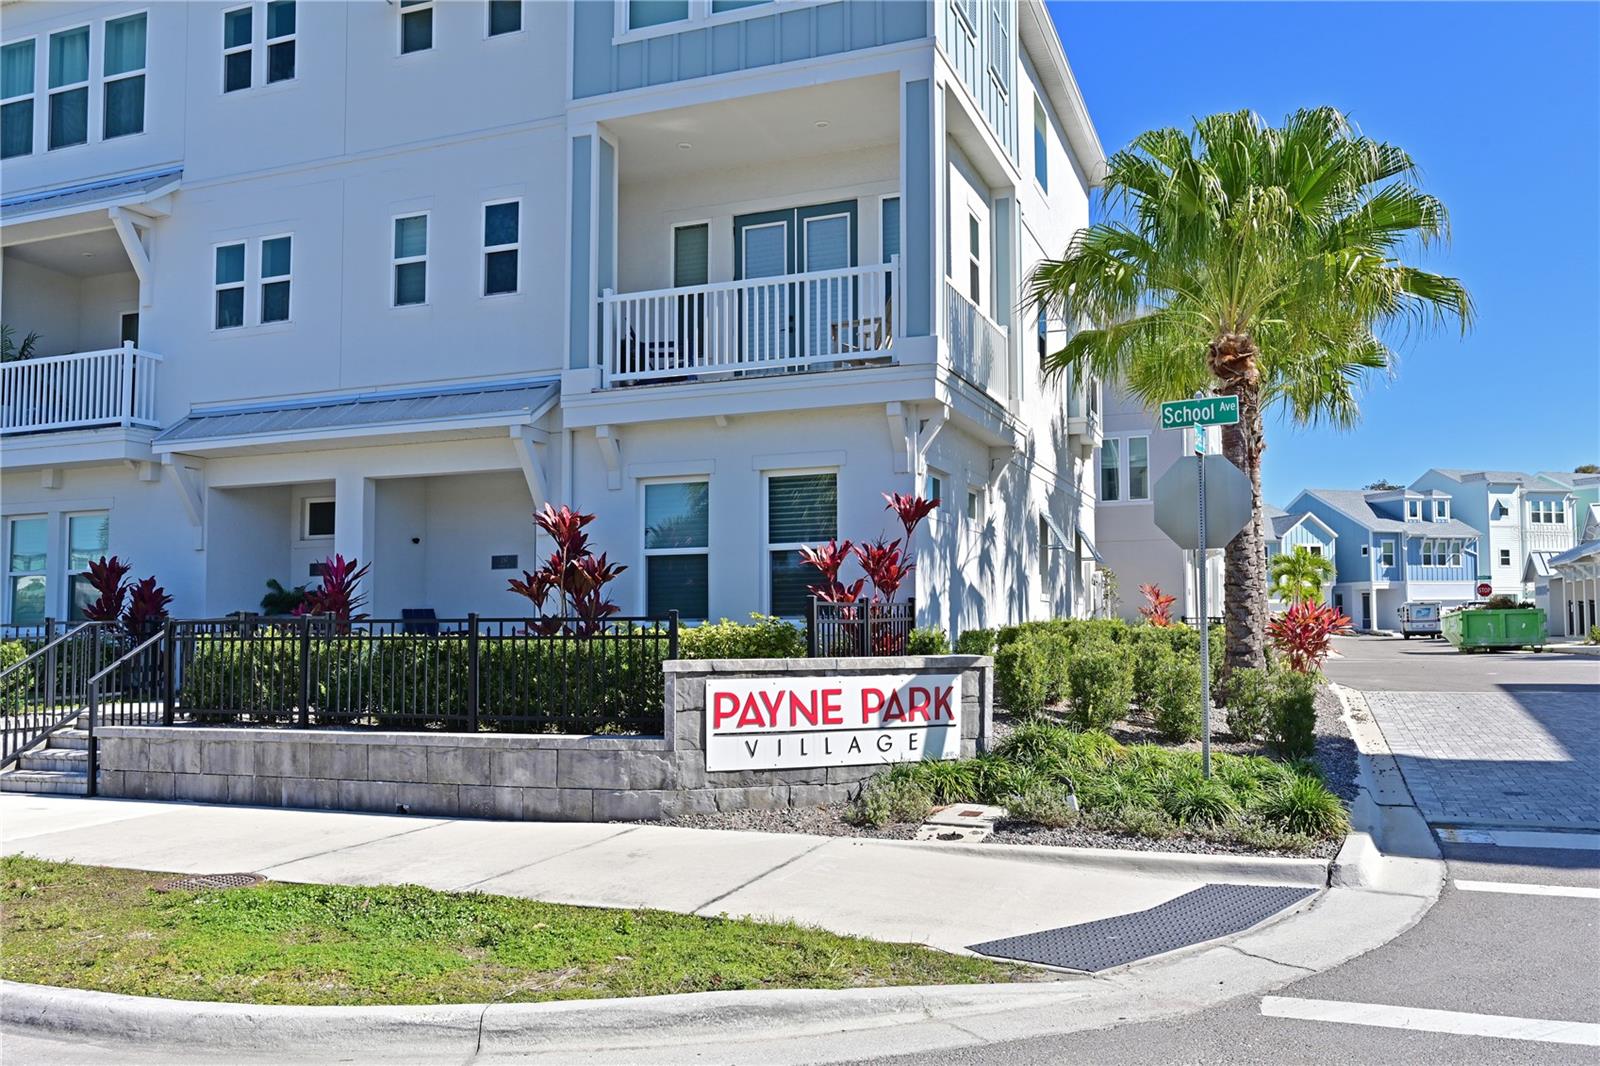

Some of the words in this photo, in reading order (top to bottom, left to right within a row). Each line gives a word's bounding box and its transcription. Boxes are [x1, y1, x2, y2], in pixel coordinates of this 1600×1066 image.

[1164, 403, 1215, 424] School
[1219, 401, 1236, 412] Ave
[713, 688, 844, 730] PAYNE
[861, 686, 955, 725] PARK
[744, 732, 919, 758] VILLAGE
